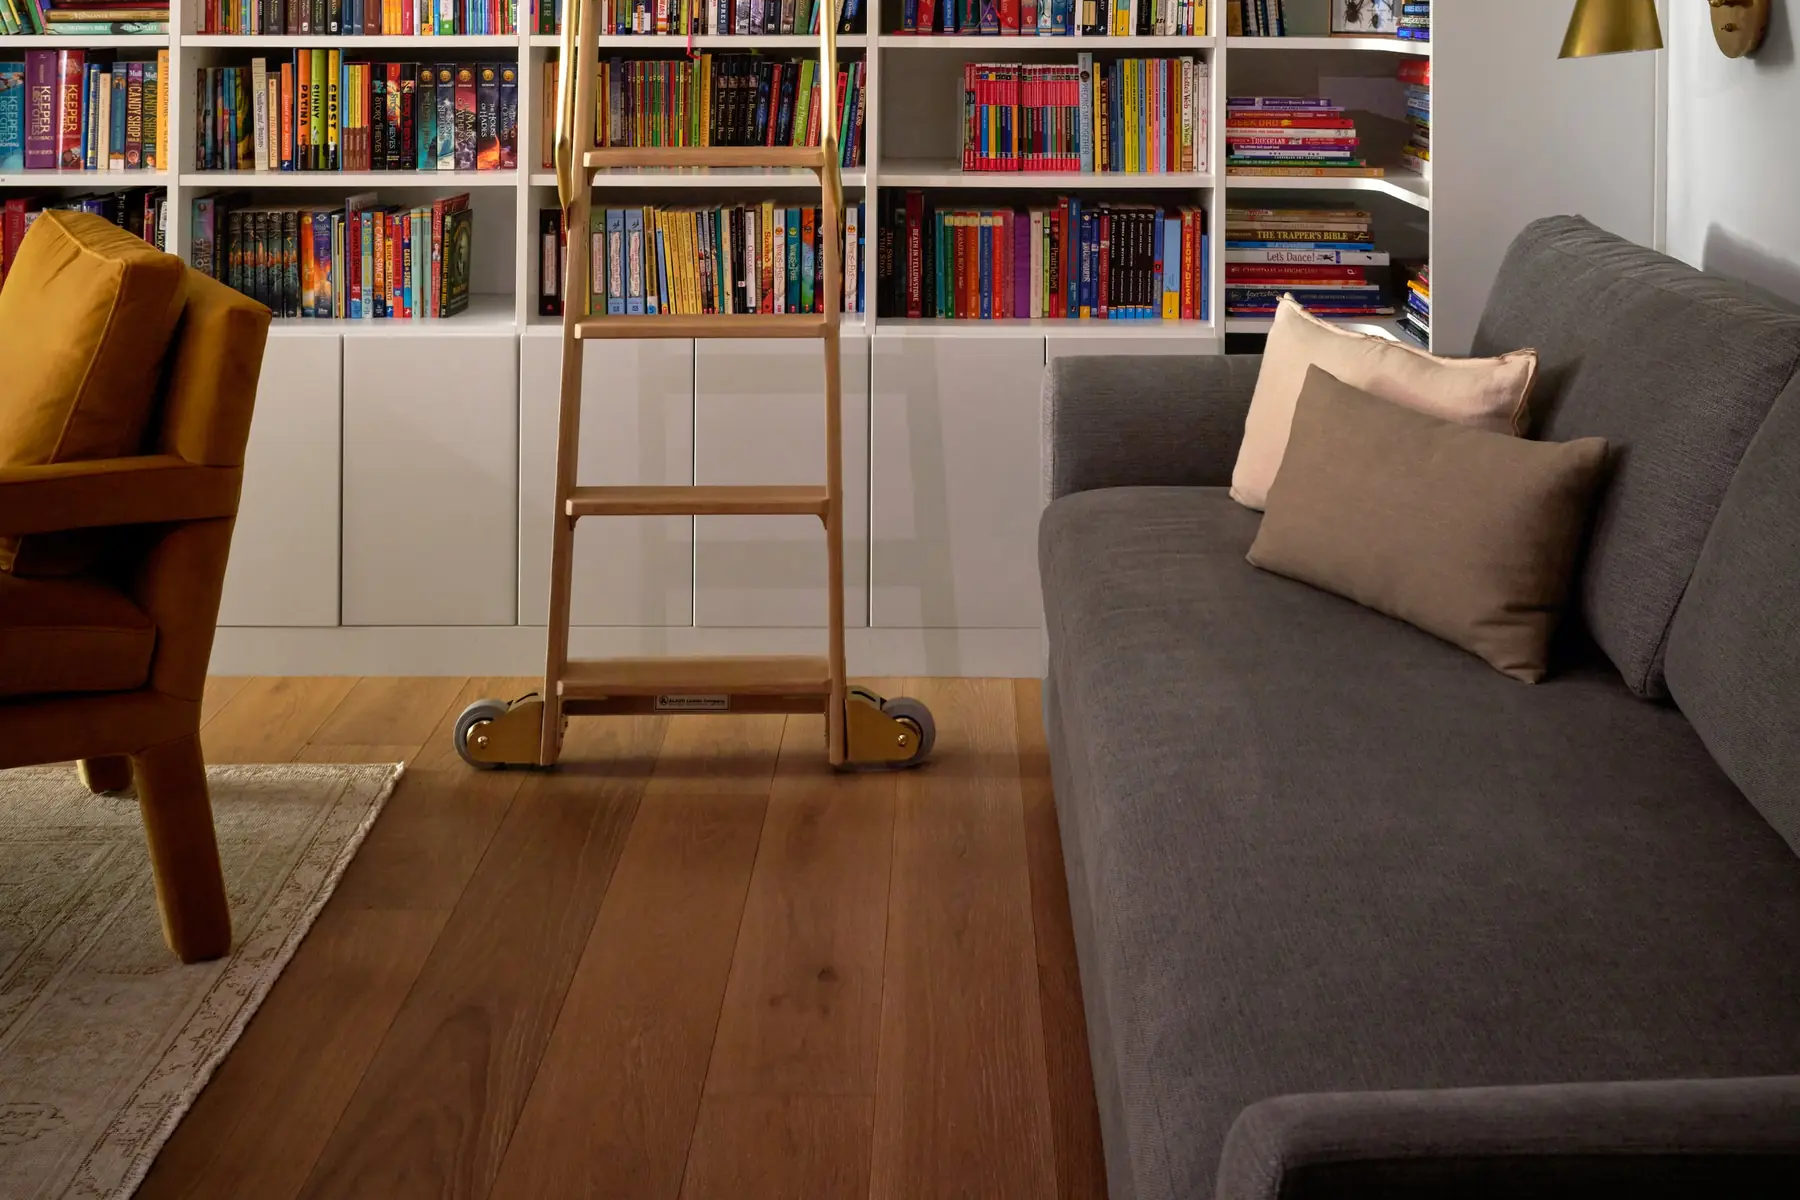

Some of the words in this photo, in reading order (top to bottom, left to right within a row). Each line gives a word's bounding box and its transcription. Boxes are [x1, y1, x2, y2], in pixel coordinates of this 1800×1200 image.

[1183, 61, 1192, 94] Charlotte's
[128, 86, 141, 114] CANDY
[144, 87, 157, 116] CANDY
[300, 84, 308, 126] PATINA
[328, 84, 336, 129] GHOST
[388, 94, 398, 116] STORY
[749, 90, 757, 102] The
[1183, 95, 1191, 109] Web
[7, 96, 18, 141] KEEPER
[40, 86, 51, 134] KEEPER
[67, 84, 78, 132] KEEPER
[373, 96, 384, 120] STORY
[717, 103, 725, 125] Bronze
[748, 103, 756, 125] Bronze
[856, 109, 864, 127] ISLAND
[1081, 111, 1088, 120] ME
[0, 117, 8, 142] CITIES
[32, 109, 40, 136] CITIES
[127, 116, 142, 137] SHOP
[144, 117, 157, 138] SHOP
[389, 119, 398, 149] THIEVES
[456, 108, 465, 143] ATHENA
[465, 113, 474, 141] MARK
[479, 111, 488, 137] HADES
[488, 112, 496, 137] HOUSE
[717, 127, 725, 140] Bow
[746, 126, 755, 139] Bow
[797, 112, 807, 134] Piggins
[1230, 119, 1256, 127] GEEK
[374, 122, 384, 152] THIEVES
[1081, 120, 1089, 155] TOGETHER
[1250, 136, 1285, 144] TINKERLAB
[117, 194, 126, 209] THE
[375, 226, 383, 252] CAKES
[1257, 231, 1274, 240] THE
[1277, 231, 1321, 240] TRAPPER'S
[1324, 231, 1348, 240] BIBLE
[848, 241, 856, 261] WINGS
[1267, 251, 1284, 261] Let's
[1286, 251, 1315, 262] Dance!
[375, 259, 383, 282] SPACE
